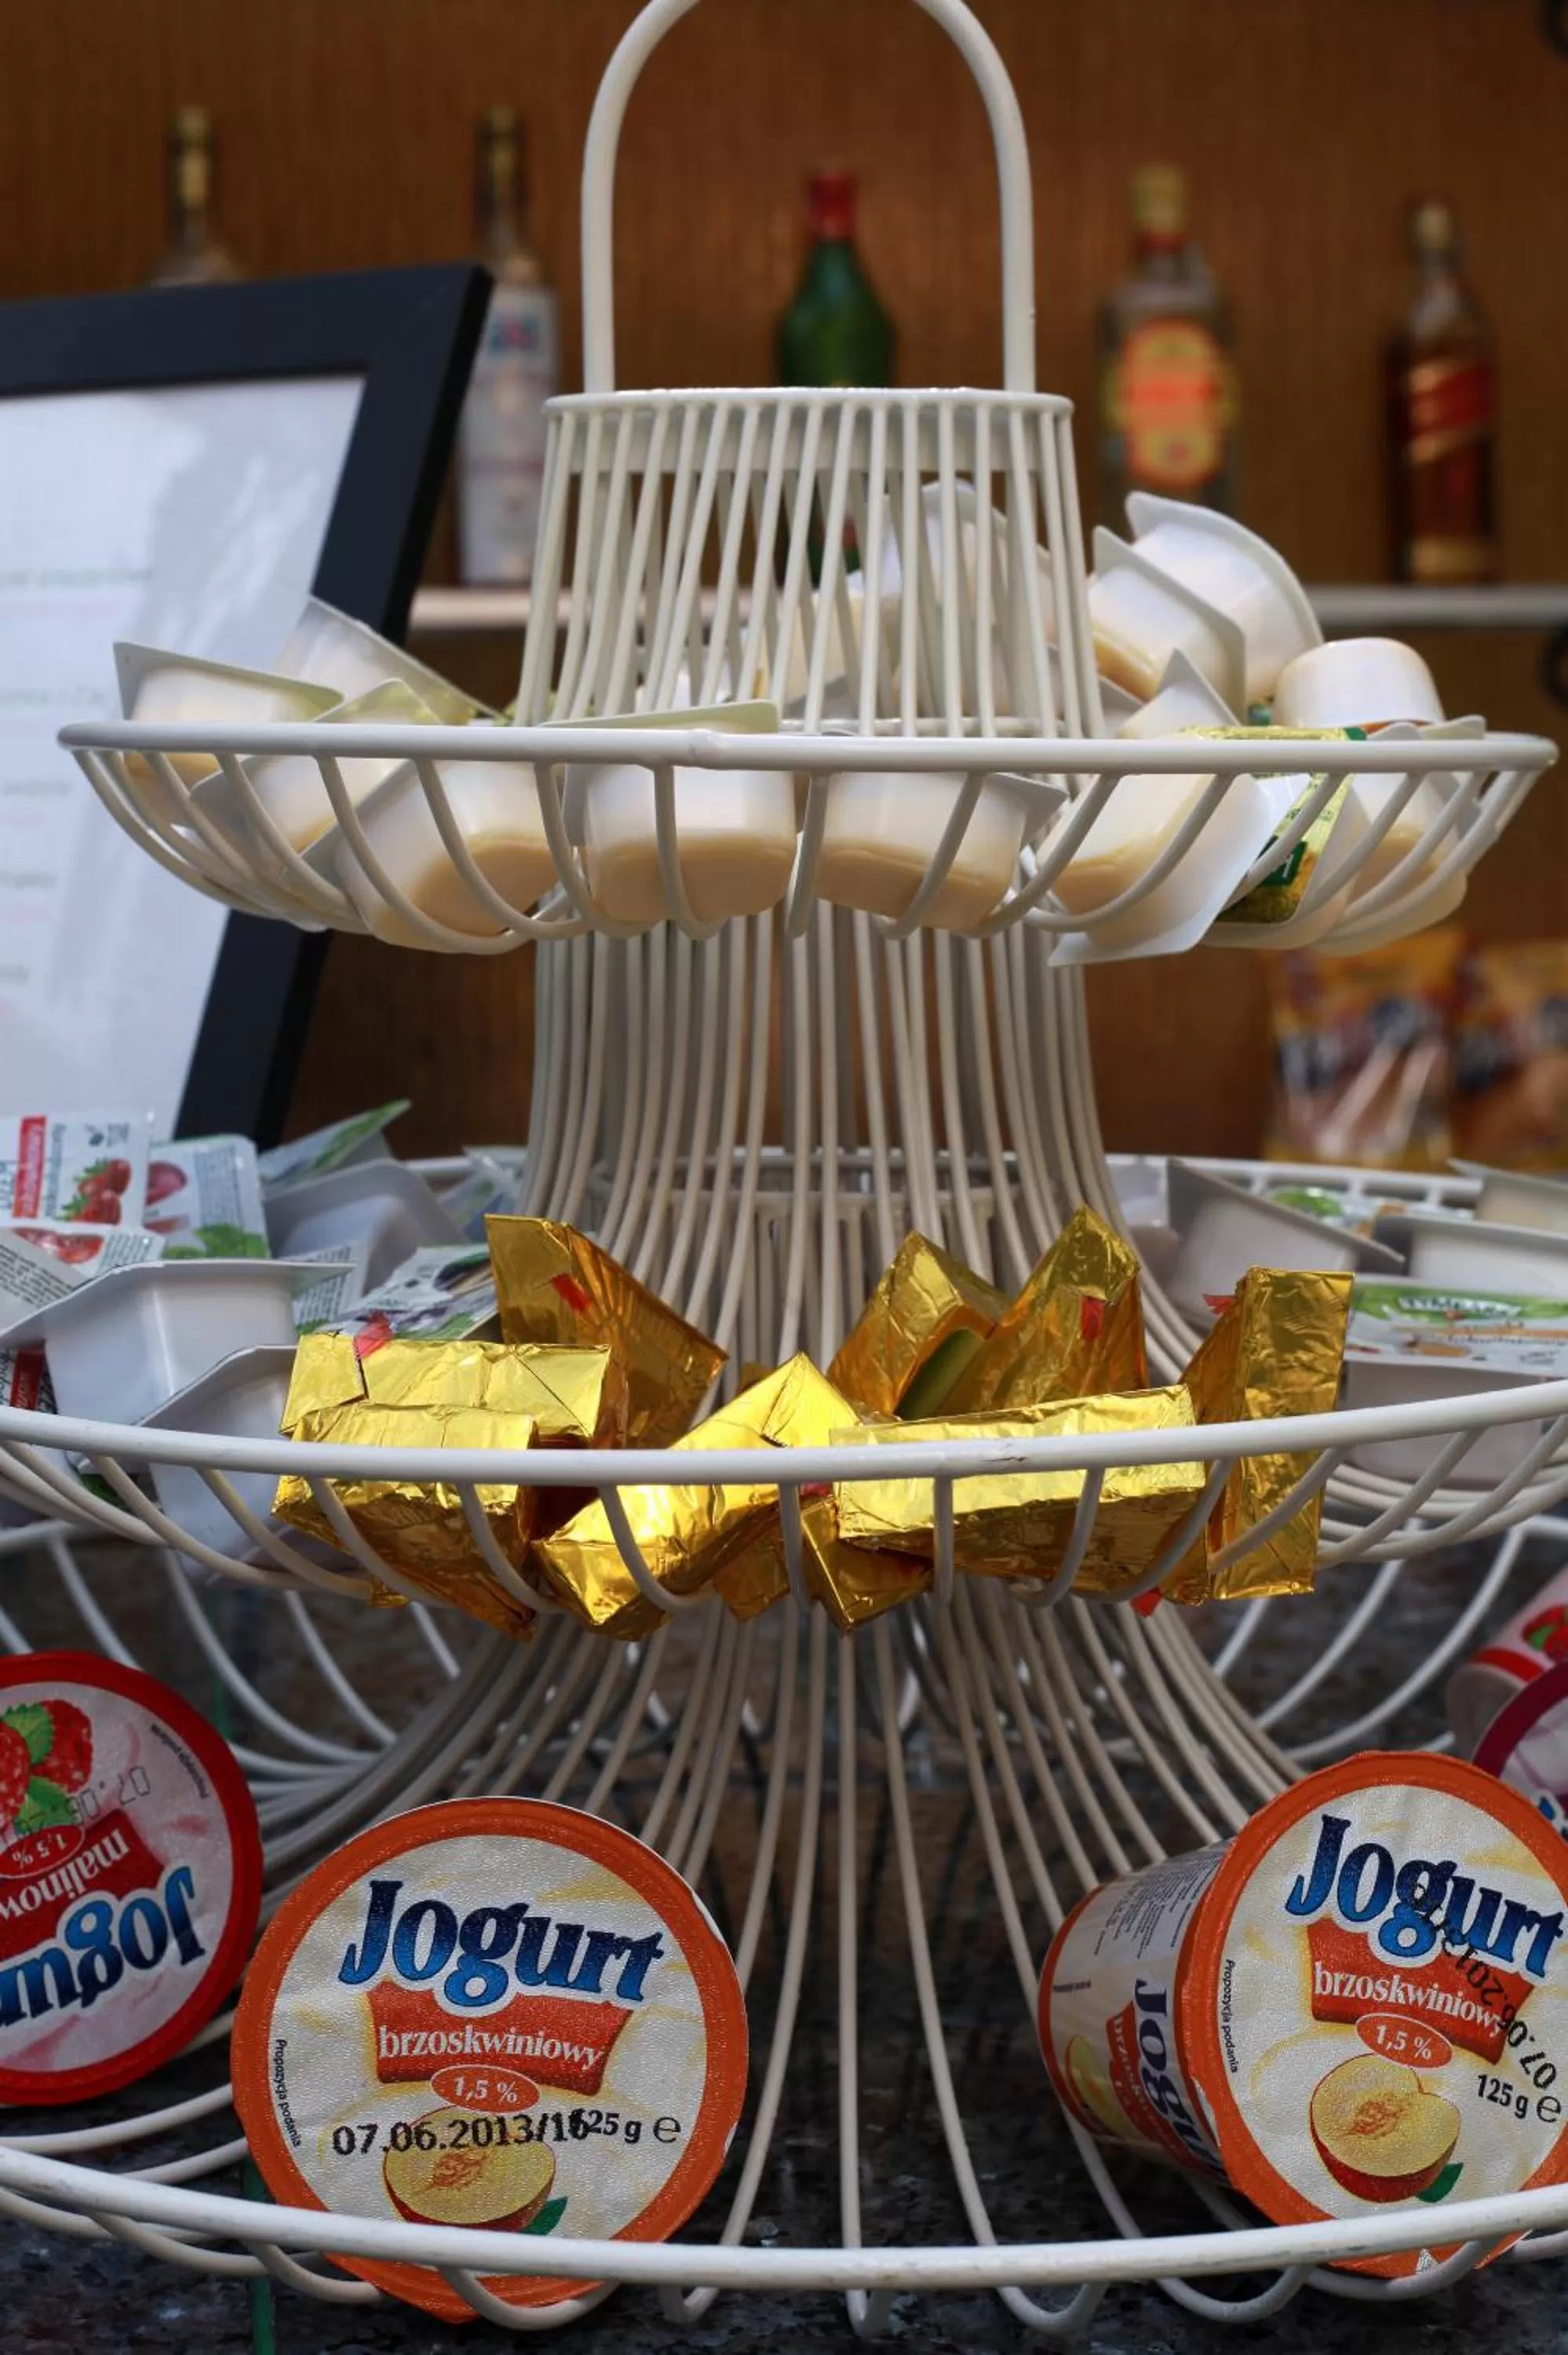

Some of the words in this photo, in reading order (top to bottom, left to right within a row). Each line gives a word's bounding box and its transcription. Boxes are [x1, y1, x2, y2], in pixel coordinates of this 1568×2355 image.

[1285, 1814, 1564, 1978] Jogurt
[338, 1880, 665, 2007] Jogurt
[1220, 1959, 1235, 2021] Propozycja
[1315, 1961, 1508, 2038] brzoskwiniowy
[273, 2039, 288, 2101] Propozycja
[379, 2025, 604, 2071] brzoskwiniowy
[1223, 2024, 1238, 2073] podania
[1375, 2025, 1407, 2050] 1,5
[1414, 2036, 1432, 2060] %
[454, 2076, 490, 2101] 1,5
[497, 2081, 518, 2104] %
[279, 2102, 302, 2148] podania
